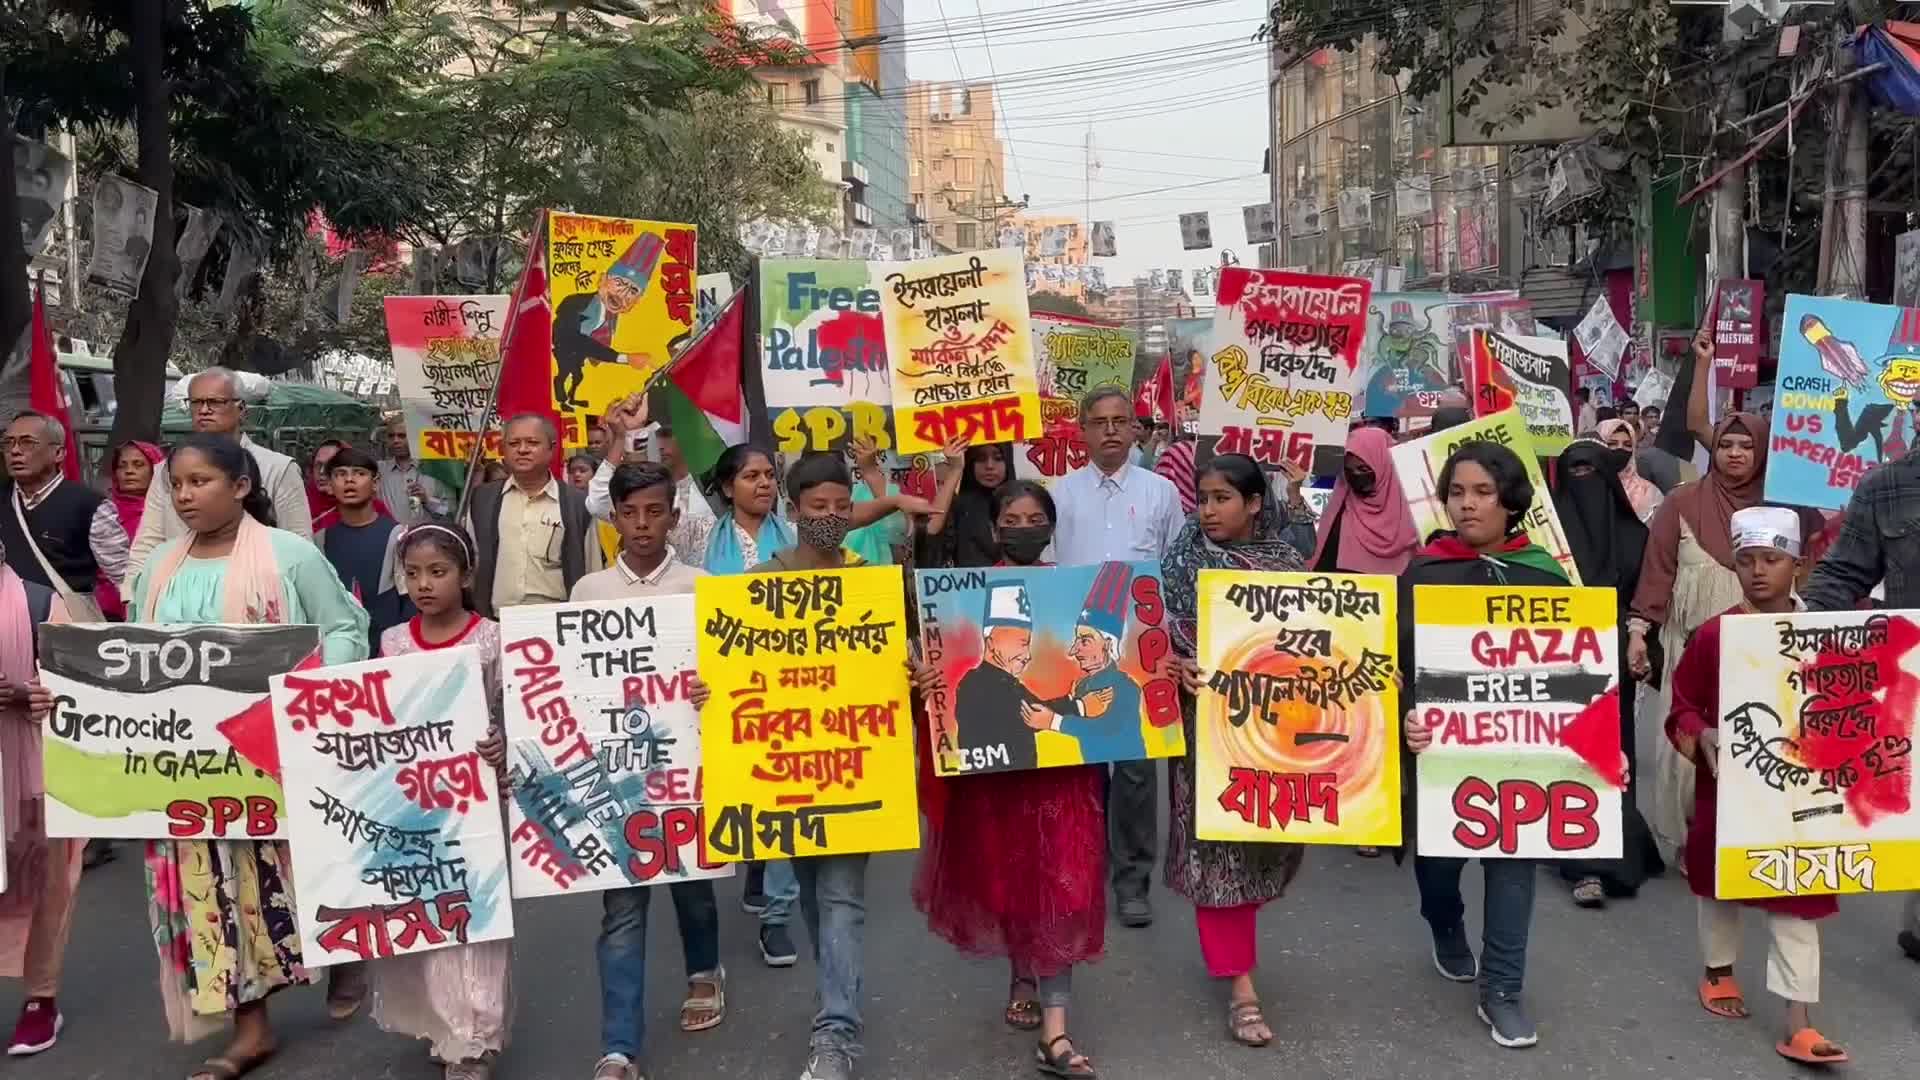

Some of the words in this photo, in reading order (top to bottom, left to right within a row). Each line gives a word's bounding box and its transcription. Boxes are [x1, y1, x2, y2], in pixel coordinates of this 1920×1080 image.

[787, 272, 881, 311] Free
[923, 299, 990, 332] হামলা
[1717, 320, 1734, 331] FREE
[1716, 333, 1754, 344] PALESTINE
[977, 374, 1015, 396] হোন
[1781, 392, 1835, 412] DOWN
[1782, 376, 1831, 393] CRASH
[773, 401, 891, 454] SPB
[913, 396, 1025, 446] বাসদ
[1786, 412, 1823, 434] US
[1027, 437, 1089, 476] বাস
[1213, 425, 1315, 473] বাসদ
[748, 575, 842, 619] গাজায়
[924, 571, 986, 596] DOWN
[1225, 576, 1380, 622] প্যালেস্টাইন
[555, 606, 657, 646] FROM
[1486, 594, 1571, 625] FREE
[705, 608, 808, 656] মানবতার
[815, 609, 896, 654] বিপর্যয়
[1131, 575, 1179, 728] SPB
[1274, 627, 1331, 658] হবে
[1471, 627, 1603, 667] GAZA
[98, 638, 232, 683] STOP
[581, 646, 657, 677] THE
[1786, 661, 1879, 698] গণহত্যার
[284, 669, 396, 732] রুখো
[622, 670, 698, 706] RIVE
[729, 670, 767, 699] এ
[778, 664, 836, 692] সময়
[1467, 671, 1551, 702] FREE
[49, 695, 193, 742] Genocide
[505, 636, 624, 828] PALESTINE
[601, 706, 651, 735] TO
[731, 698, 811, 750] নিরব
[820, 701, 899, 742] থাকা
[1424, 706, 1577, 749] PALESTINE
[125, 747, 148, 774] in
[313, 720, 455, 770] সাম্রাজ্যবাদ
[602, 737, 678, 772] THE
[751, 746, 872, 792] অন্যায়
[1811, 758, 1859, 795] এক
[167, 796, 278, 837] SPB
[1217, 766, 1339, 832] বাসদ
[1452, 776, 1600, 854] SPB
[514, 764, 574, 838] WILL
[574, 832, 617, 876] BE
[709, 800, 883, 859] বাসদ
[511, 819, 590, 890] FREE
[1746, 842, 1876, 894] বাসদ
[316, 894, 473, 959] বাসদ
